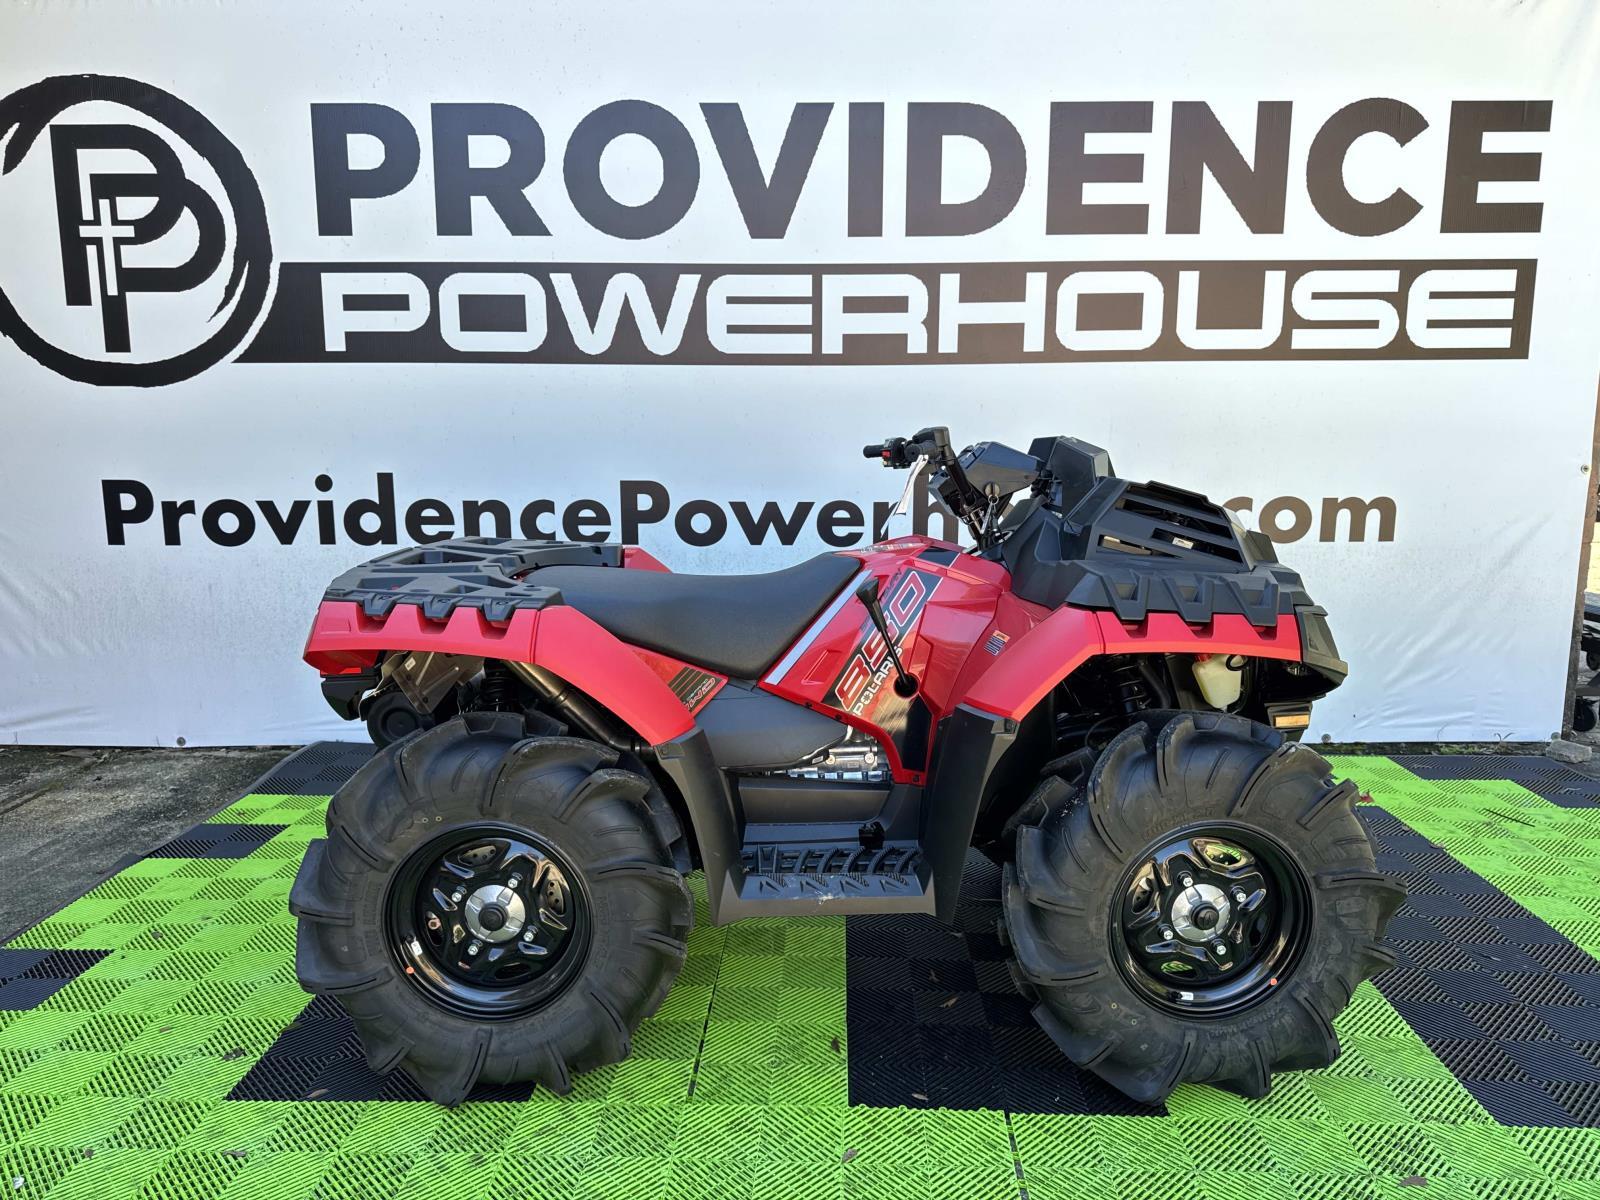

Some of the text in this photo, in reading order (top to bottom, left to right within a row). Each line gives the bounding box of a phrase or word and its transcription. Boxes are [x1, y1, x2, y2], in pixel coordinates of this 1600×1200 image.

[311, 97, 1553, 240] PROVIDENCE
[321, 268, 1517, 356] POWERHOUSE
[834, 570, 926, 711] 850
